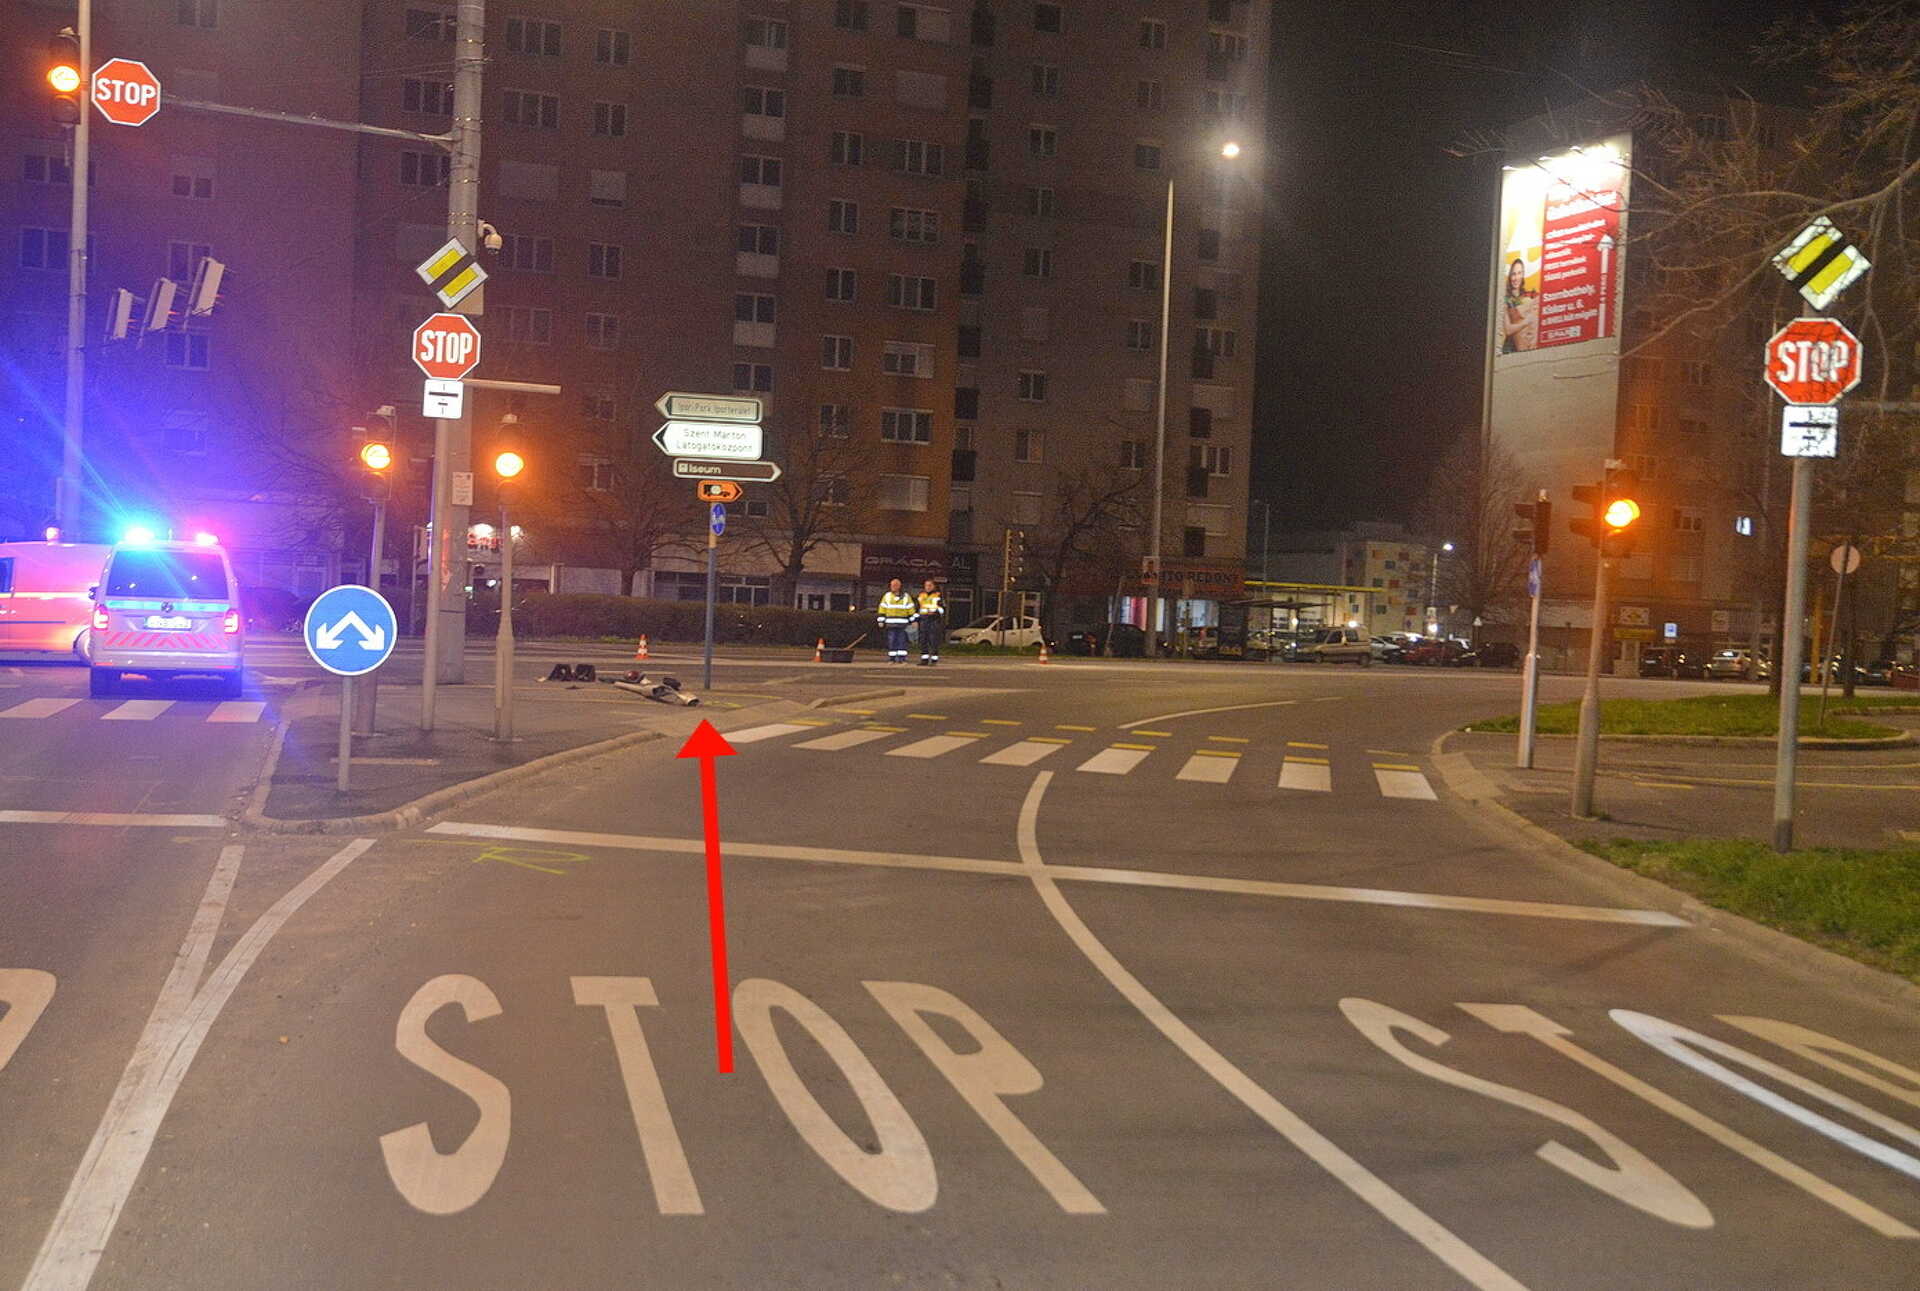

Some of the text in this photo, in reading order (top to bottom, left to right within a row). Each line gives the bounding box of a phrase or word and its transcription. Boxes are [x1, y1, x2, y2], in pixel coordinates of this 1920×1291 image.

[96, 77, 156, 107] STOP
[420, 329, 473, 365] STOP
[1776, 340, 1849, 382] STOP
[379, 974, 1107, 1215] STOP
